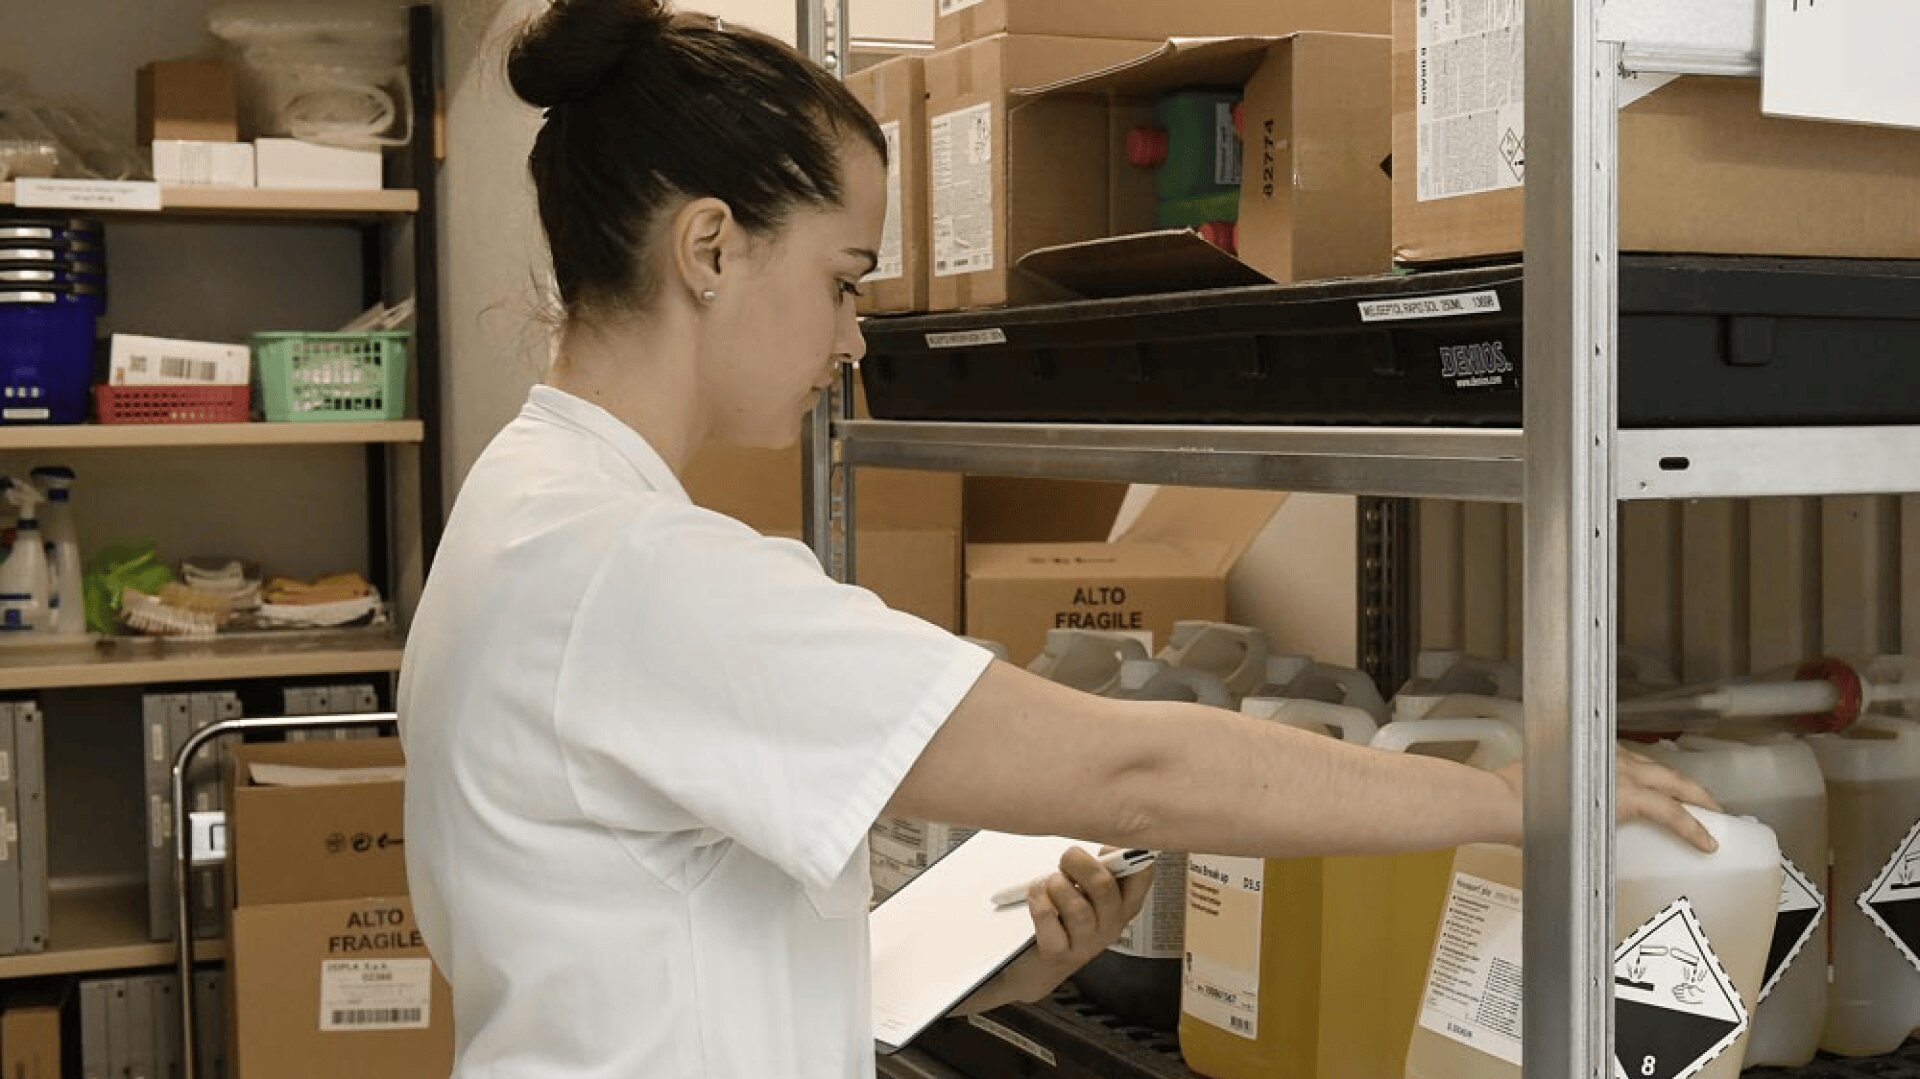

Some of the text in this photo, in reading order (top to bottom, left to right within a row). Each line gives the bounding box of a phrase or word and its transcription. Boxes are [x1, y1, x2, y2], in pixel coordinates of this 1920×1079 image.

[1263, 119, 1274, 197] 82774
[1073, 586, 1126, 606] ALTO
[1055, 611, 1144, 630] FRAGILE
[347, 908, 404, 928] ALTO
[329, 931, 424, 953] FRAGILE
[1641, 1055, 1656, 1076] 8
